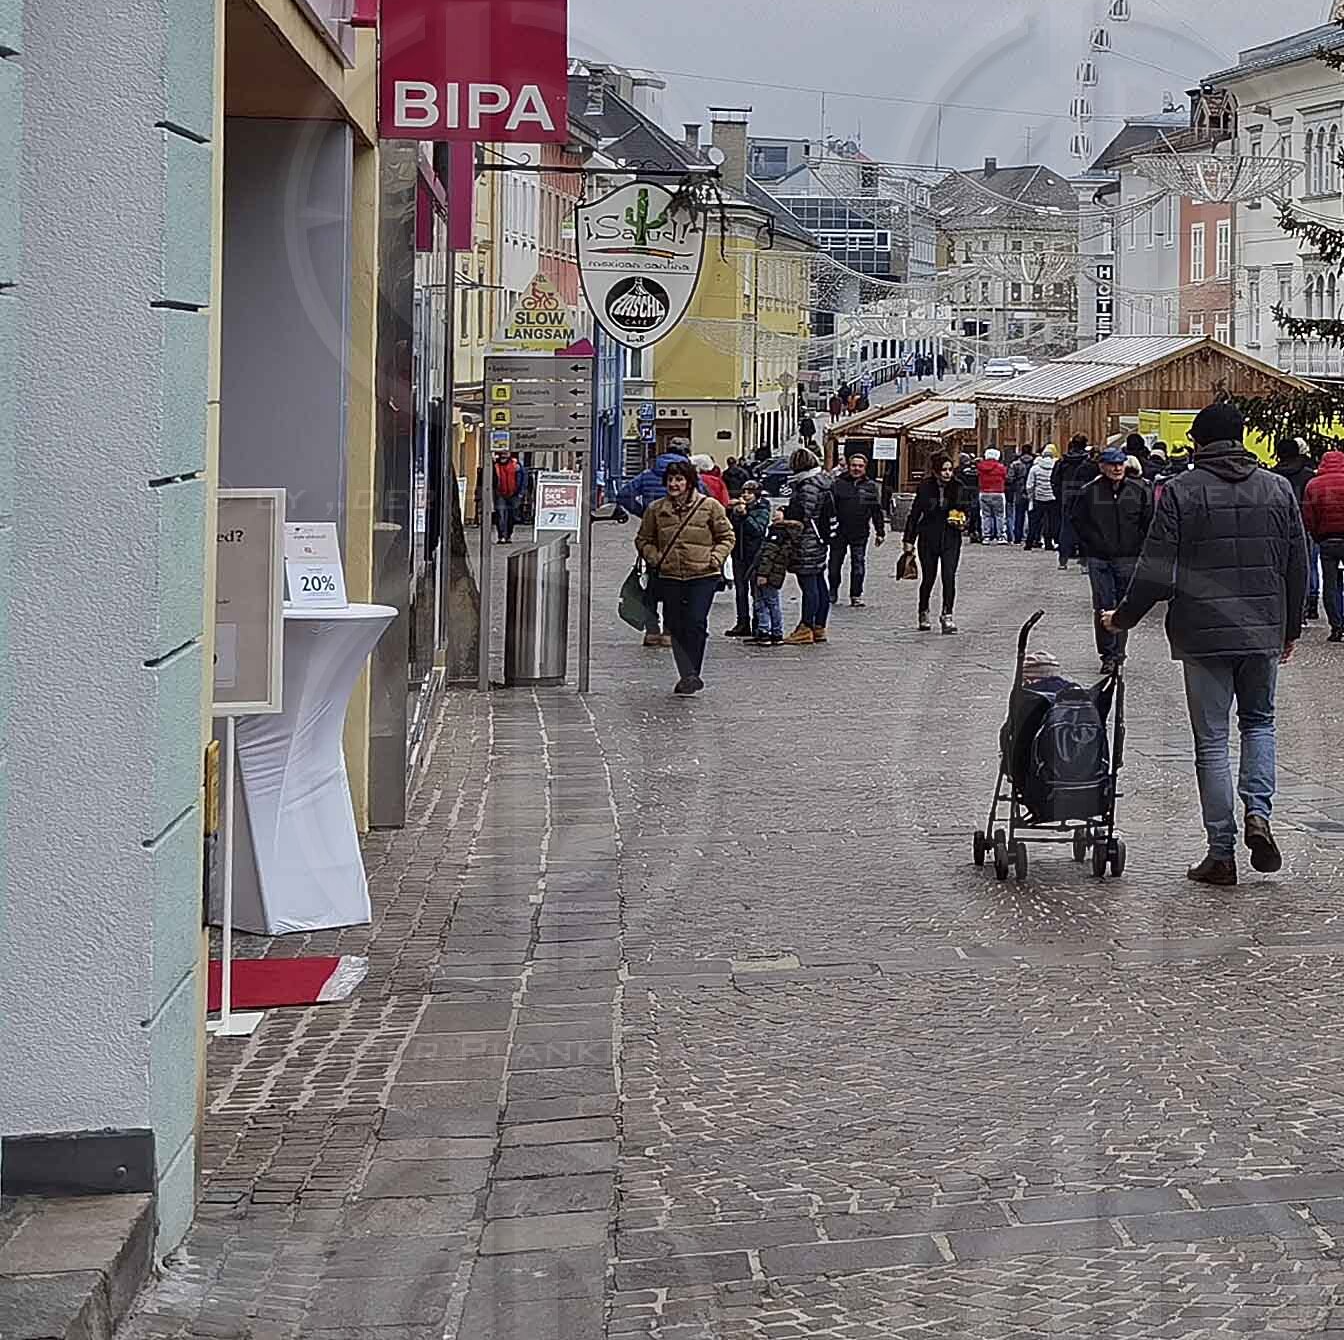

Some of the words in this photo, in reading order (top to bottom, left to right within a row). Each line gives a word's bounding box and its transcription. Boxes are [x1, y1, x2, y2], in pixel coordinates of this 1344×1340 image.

[394, 81, 555, 131] BIPA
[588, 259, 640, 269] mexican
[644, 260, 690, 271] cantina
[514, 311, 565, 325] SLOW
[504, 328, 575, 340] LANGSAM
[300, 575, 336, 592] 20%
